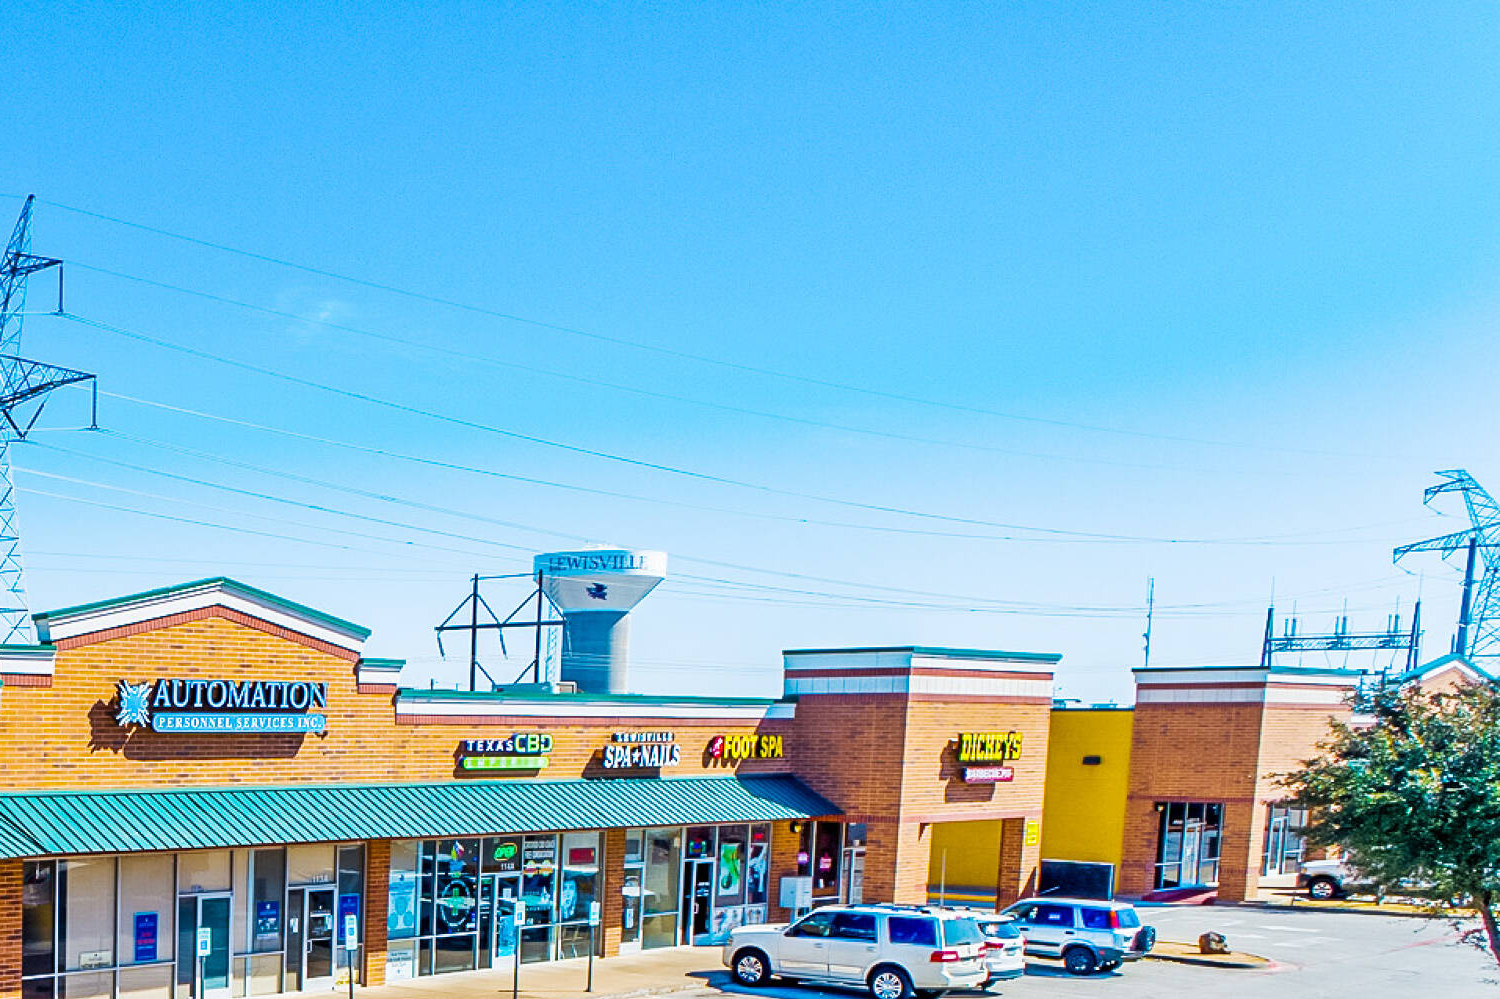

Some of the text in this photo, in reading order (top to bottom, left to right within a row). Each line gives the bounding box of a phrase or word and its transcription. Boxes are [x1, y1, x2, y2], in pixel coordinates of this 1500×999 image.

[153, 679, 329, 708] AUTOMATION
[158, 717, 322, 728] PERSONNEL SERVICES INC.
[466, 734, 553, 753] TEXAS CBD
[723, 735, 783, 759] FOOT SPA
[959, 732, 1023, 761] DICKEY'S
[604, 744, 681, 768] SPA NAILS
